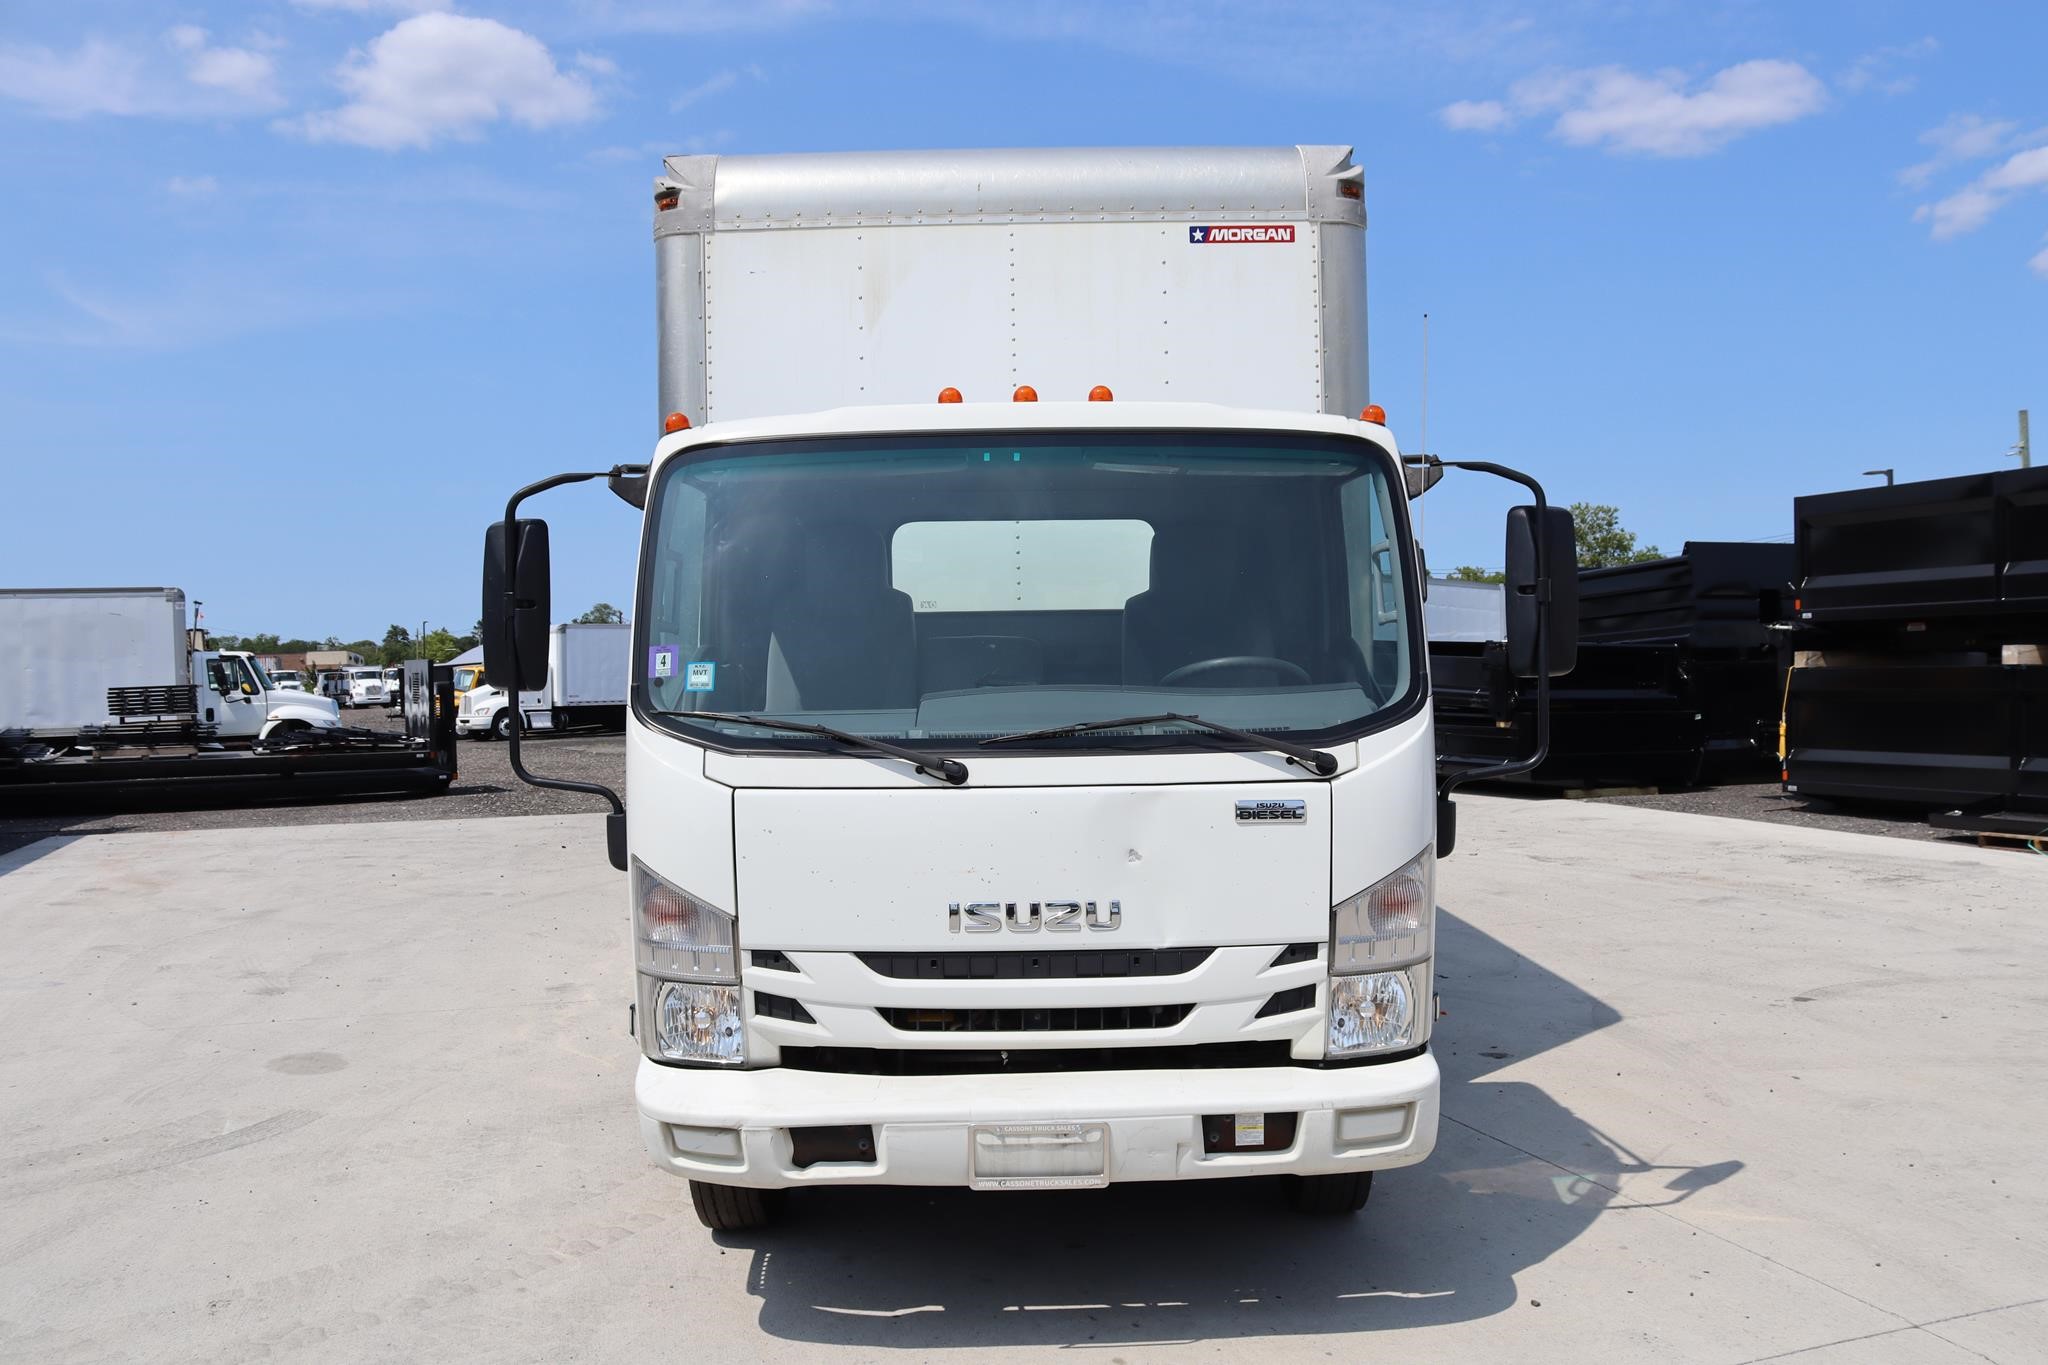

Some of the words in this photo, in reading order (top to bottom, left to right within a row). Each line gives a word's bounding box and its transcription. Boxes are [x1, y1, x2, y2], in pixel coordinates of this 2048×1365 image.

[1209, 228, 1291, 241] MORGAN
[660, 654, 667, 668] 4
[1239, 810, 1303, 820] DIESEL
[948, 901, 1122, 933] ISUZU
